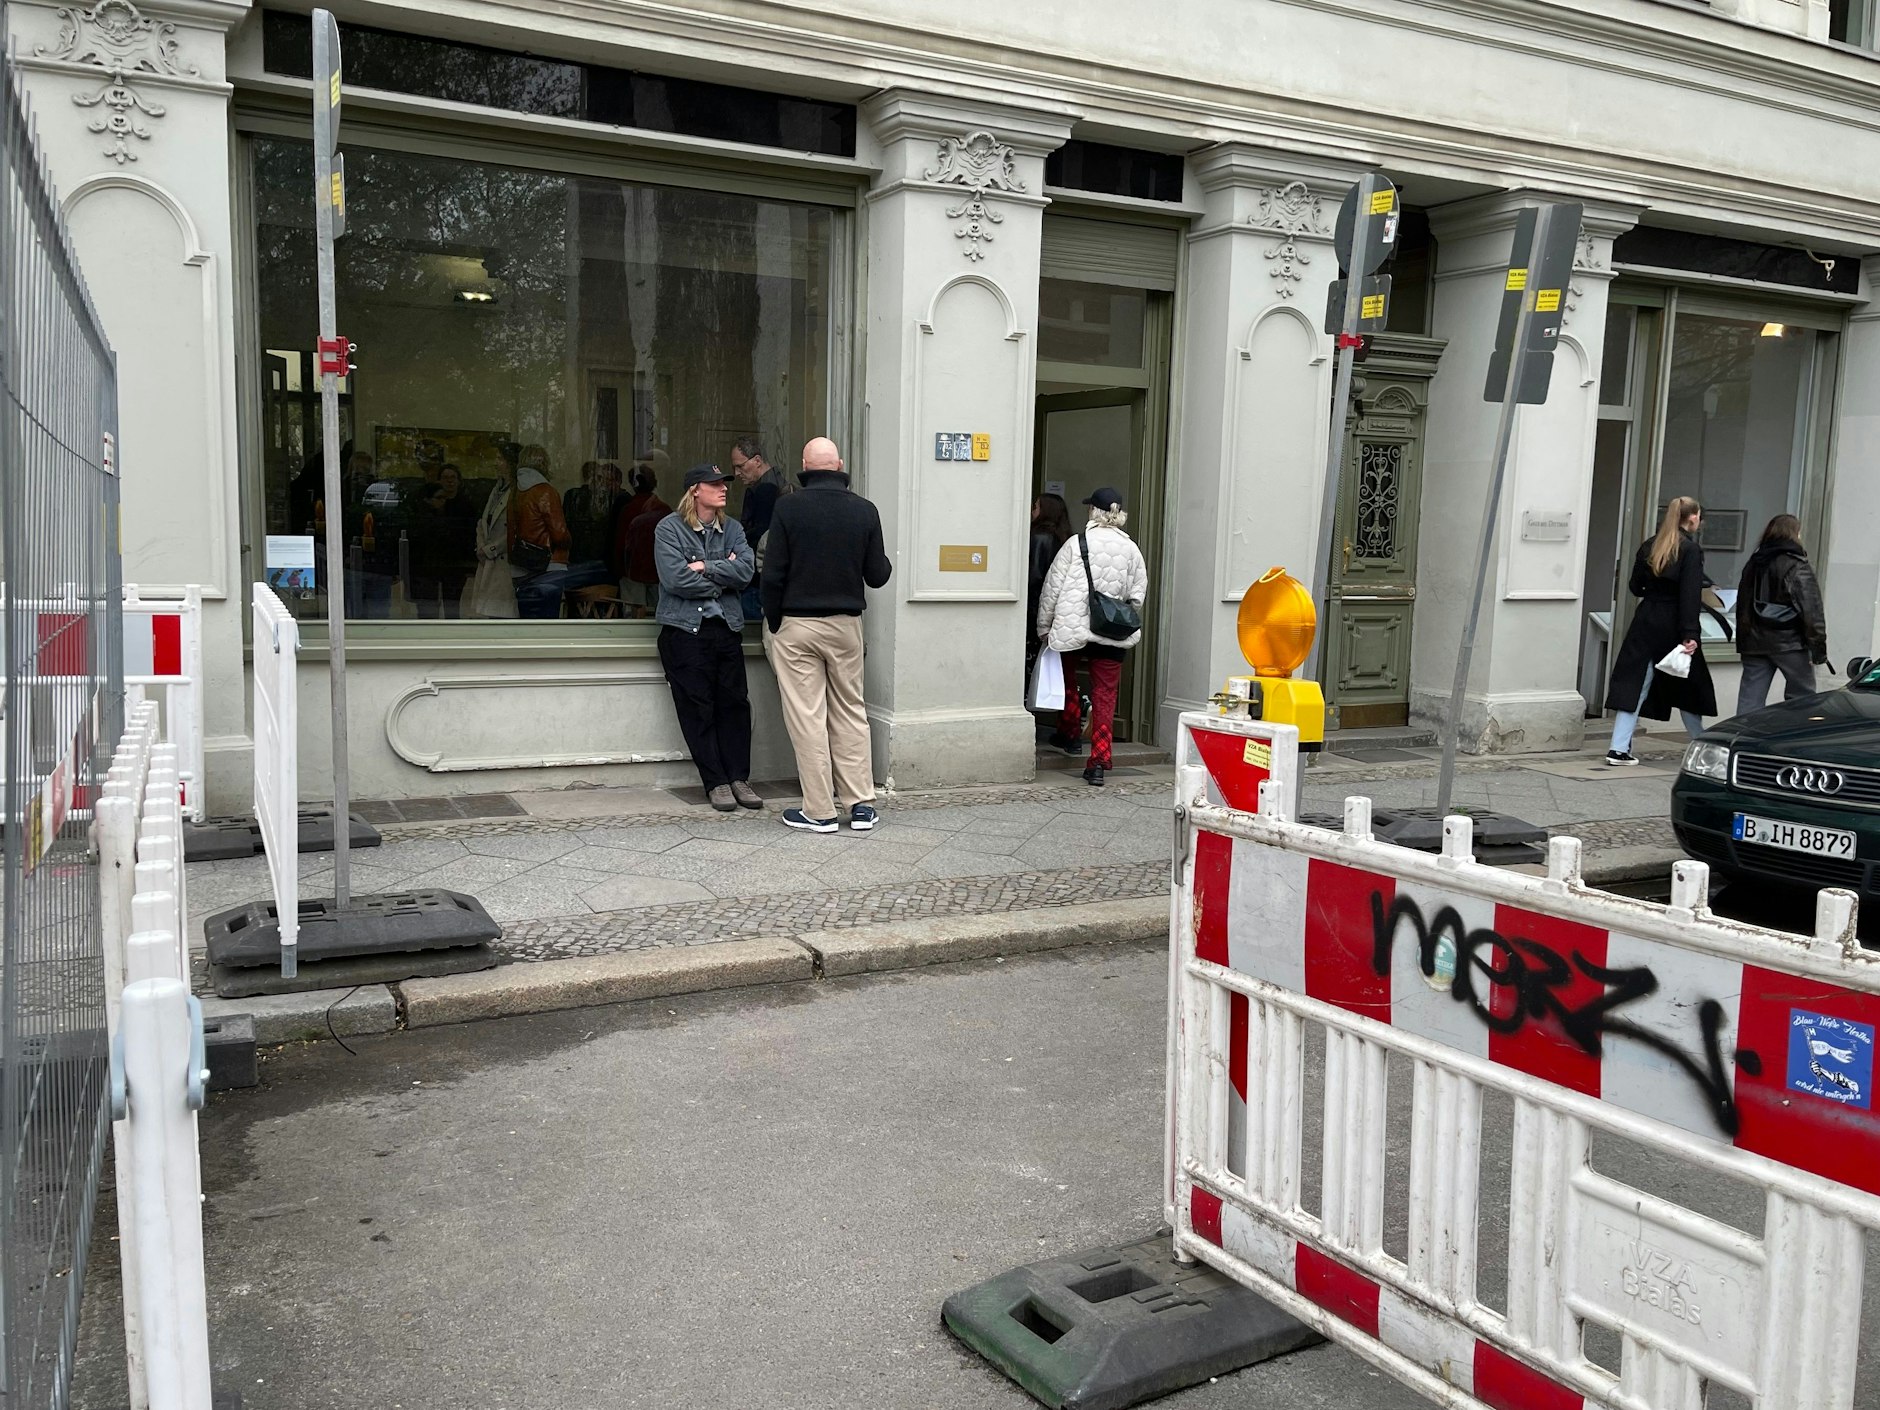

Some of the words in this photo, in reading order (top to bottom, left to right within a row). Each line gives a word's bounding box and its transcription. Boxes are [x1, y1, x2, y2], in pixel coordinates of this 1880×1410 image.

[1744, 819, 1756, 838] B
[1770, 824, 1795, 846] IH
[1799, 829, 1852, 854] 8879
[1843, 1022, 1871, 1045] Hertha
[1795, 1080, 1814, 1091] wird
[1812, 1086, 1822, 1094] nie
[1628, 1241, 1697, 1294] VZA
[1622, 1267, 1702, 1325] Bialas
